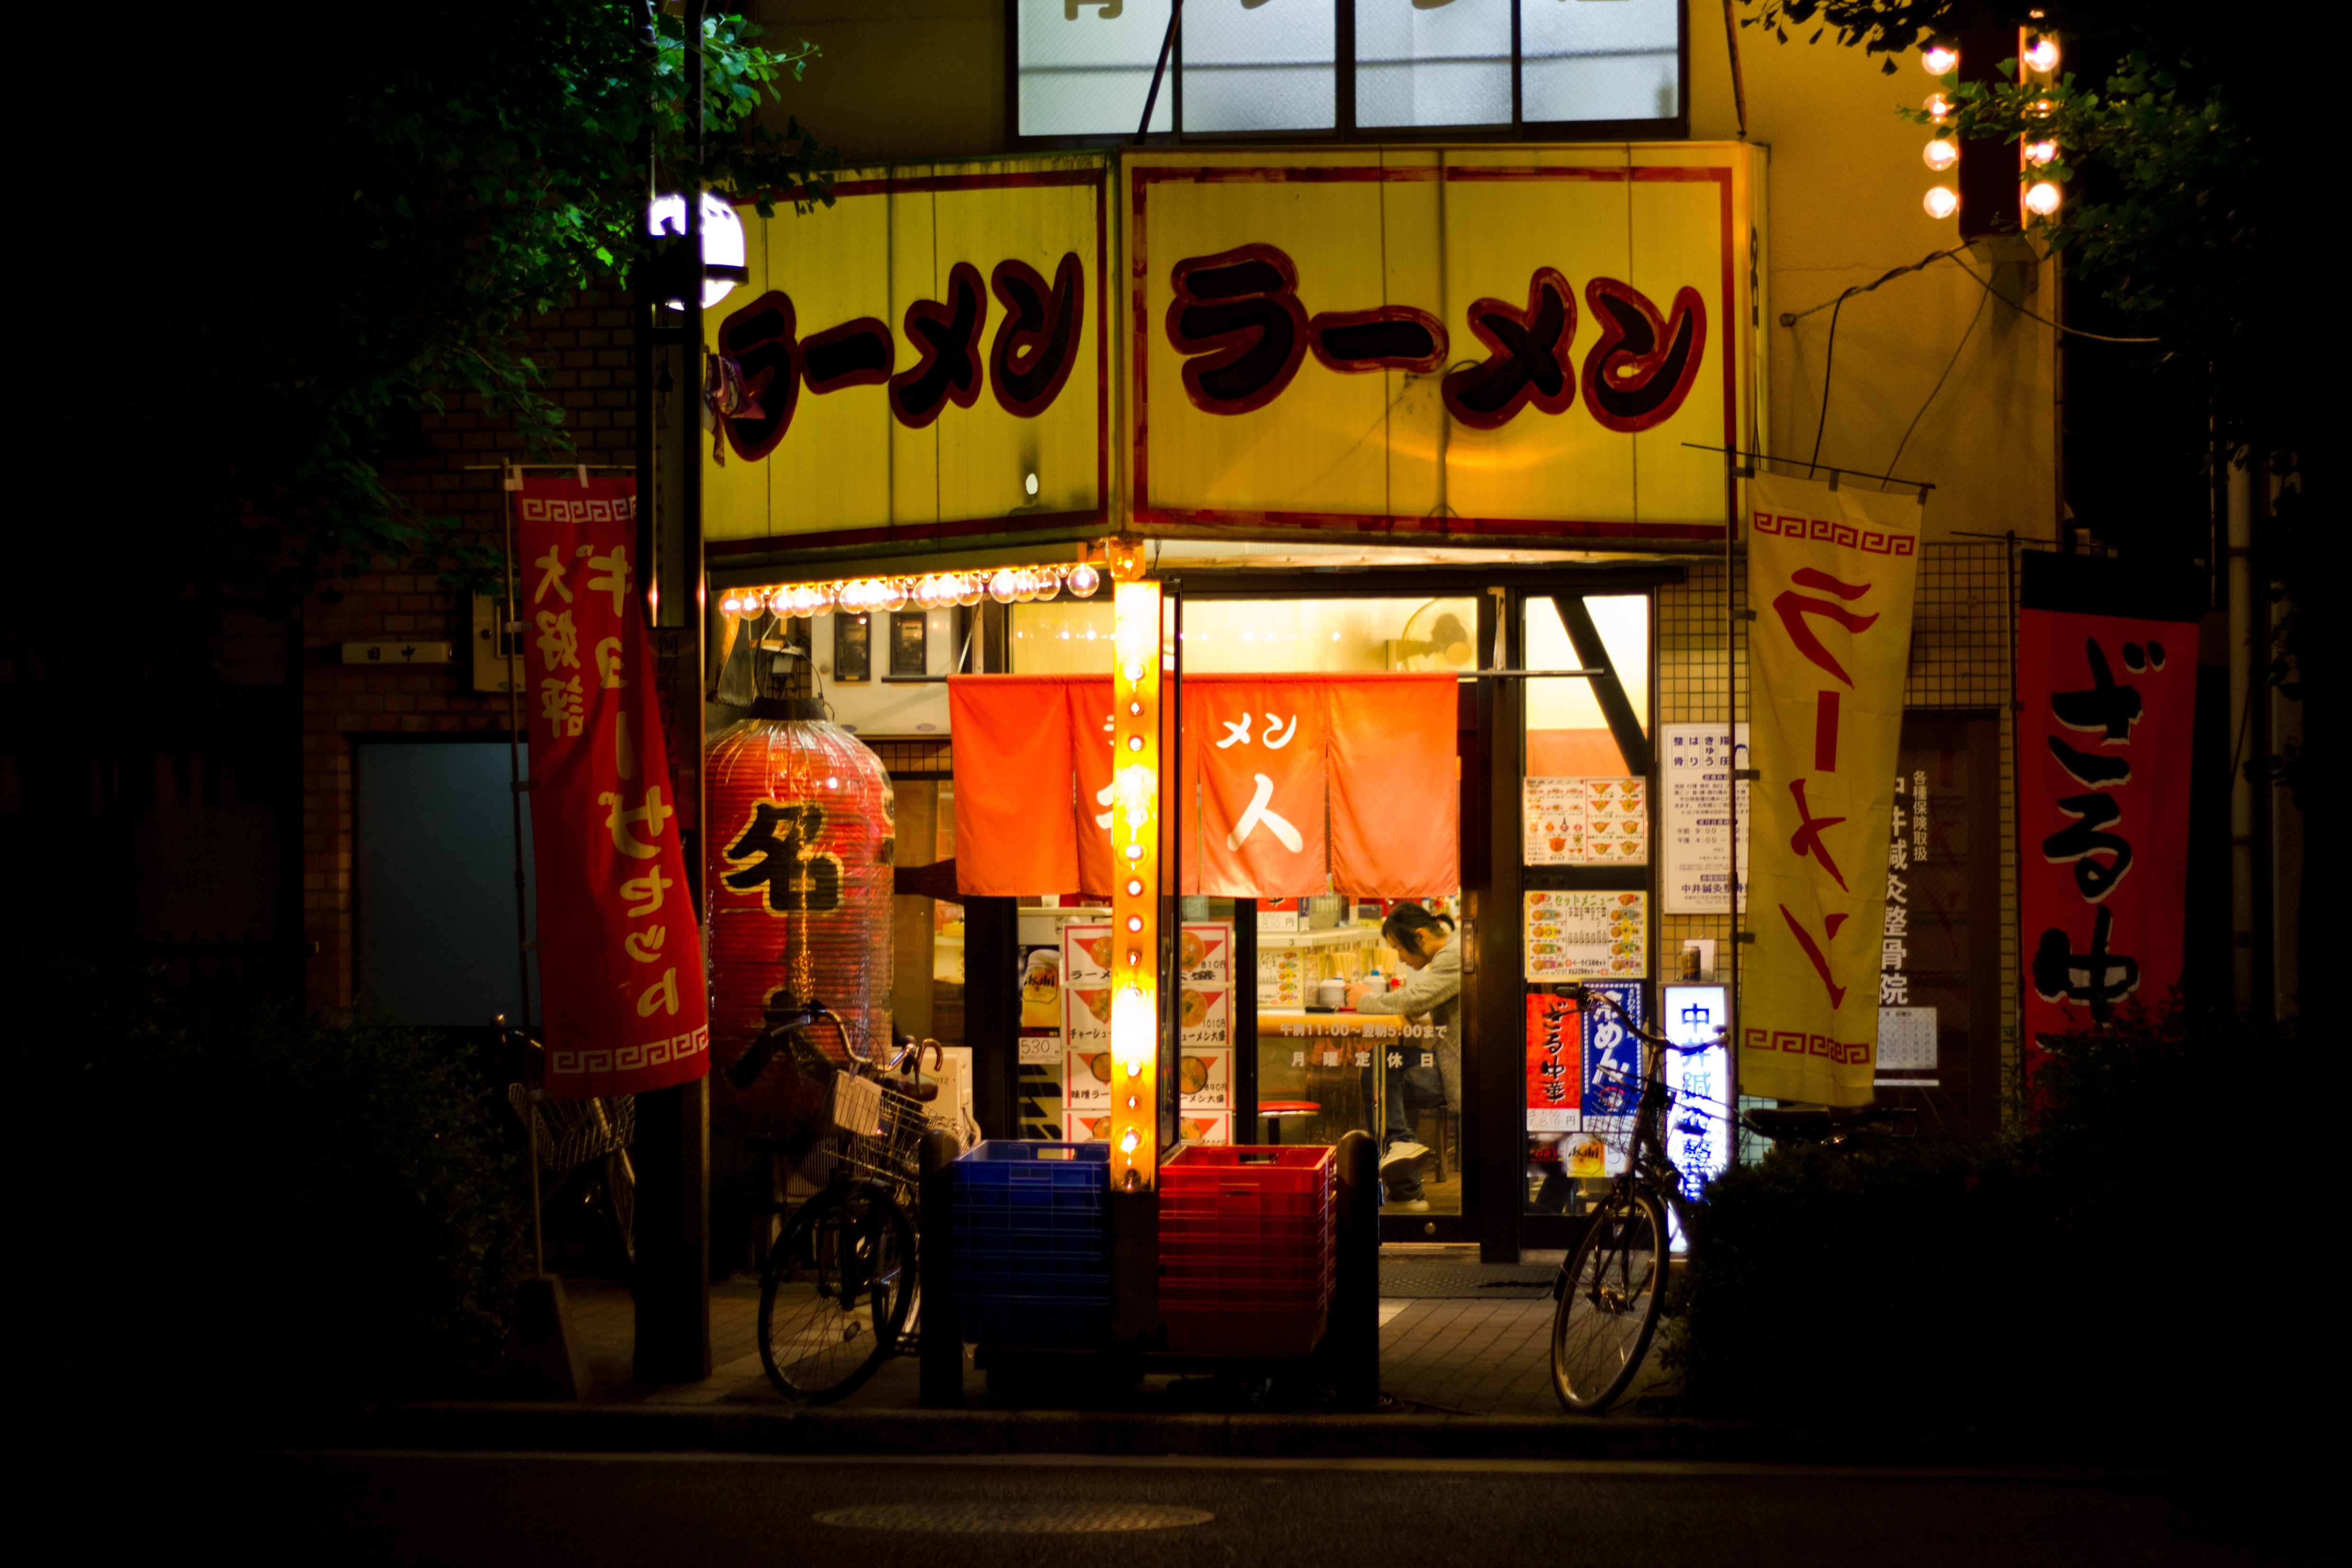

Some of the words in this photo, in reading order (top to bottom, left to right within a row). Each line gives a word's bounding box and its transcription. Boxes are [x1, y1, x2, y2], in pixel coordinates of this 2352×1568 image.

[719, 252, 1084, 462] ラーメン
[1166, 243, 1706, 433] ラーメン
[1681, 884, 1748, 894] 中井鍼灸整骨
[2033, 636, 2165, 1055] ざる中
[1201, 961, 1226, 969] 810円
[1021, 1039, 1050, 1054] 530
